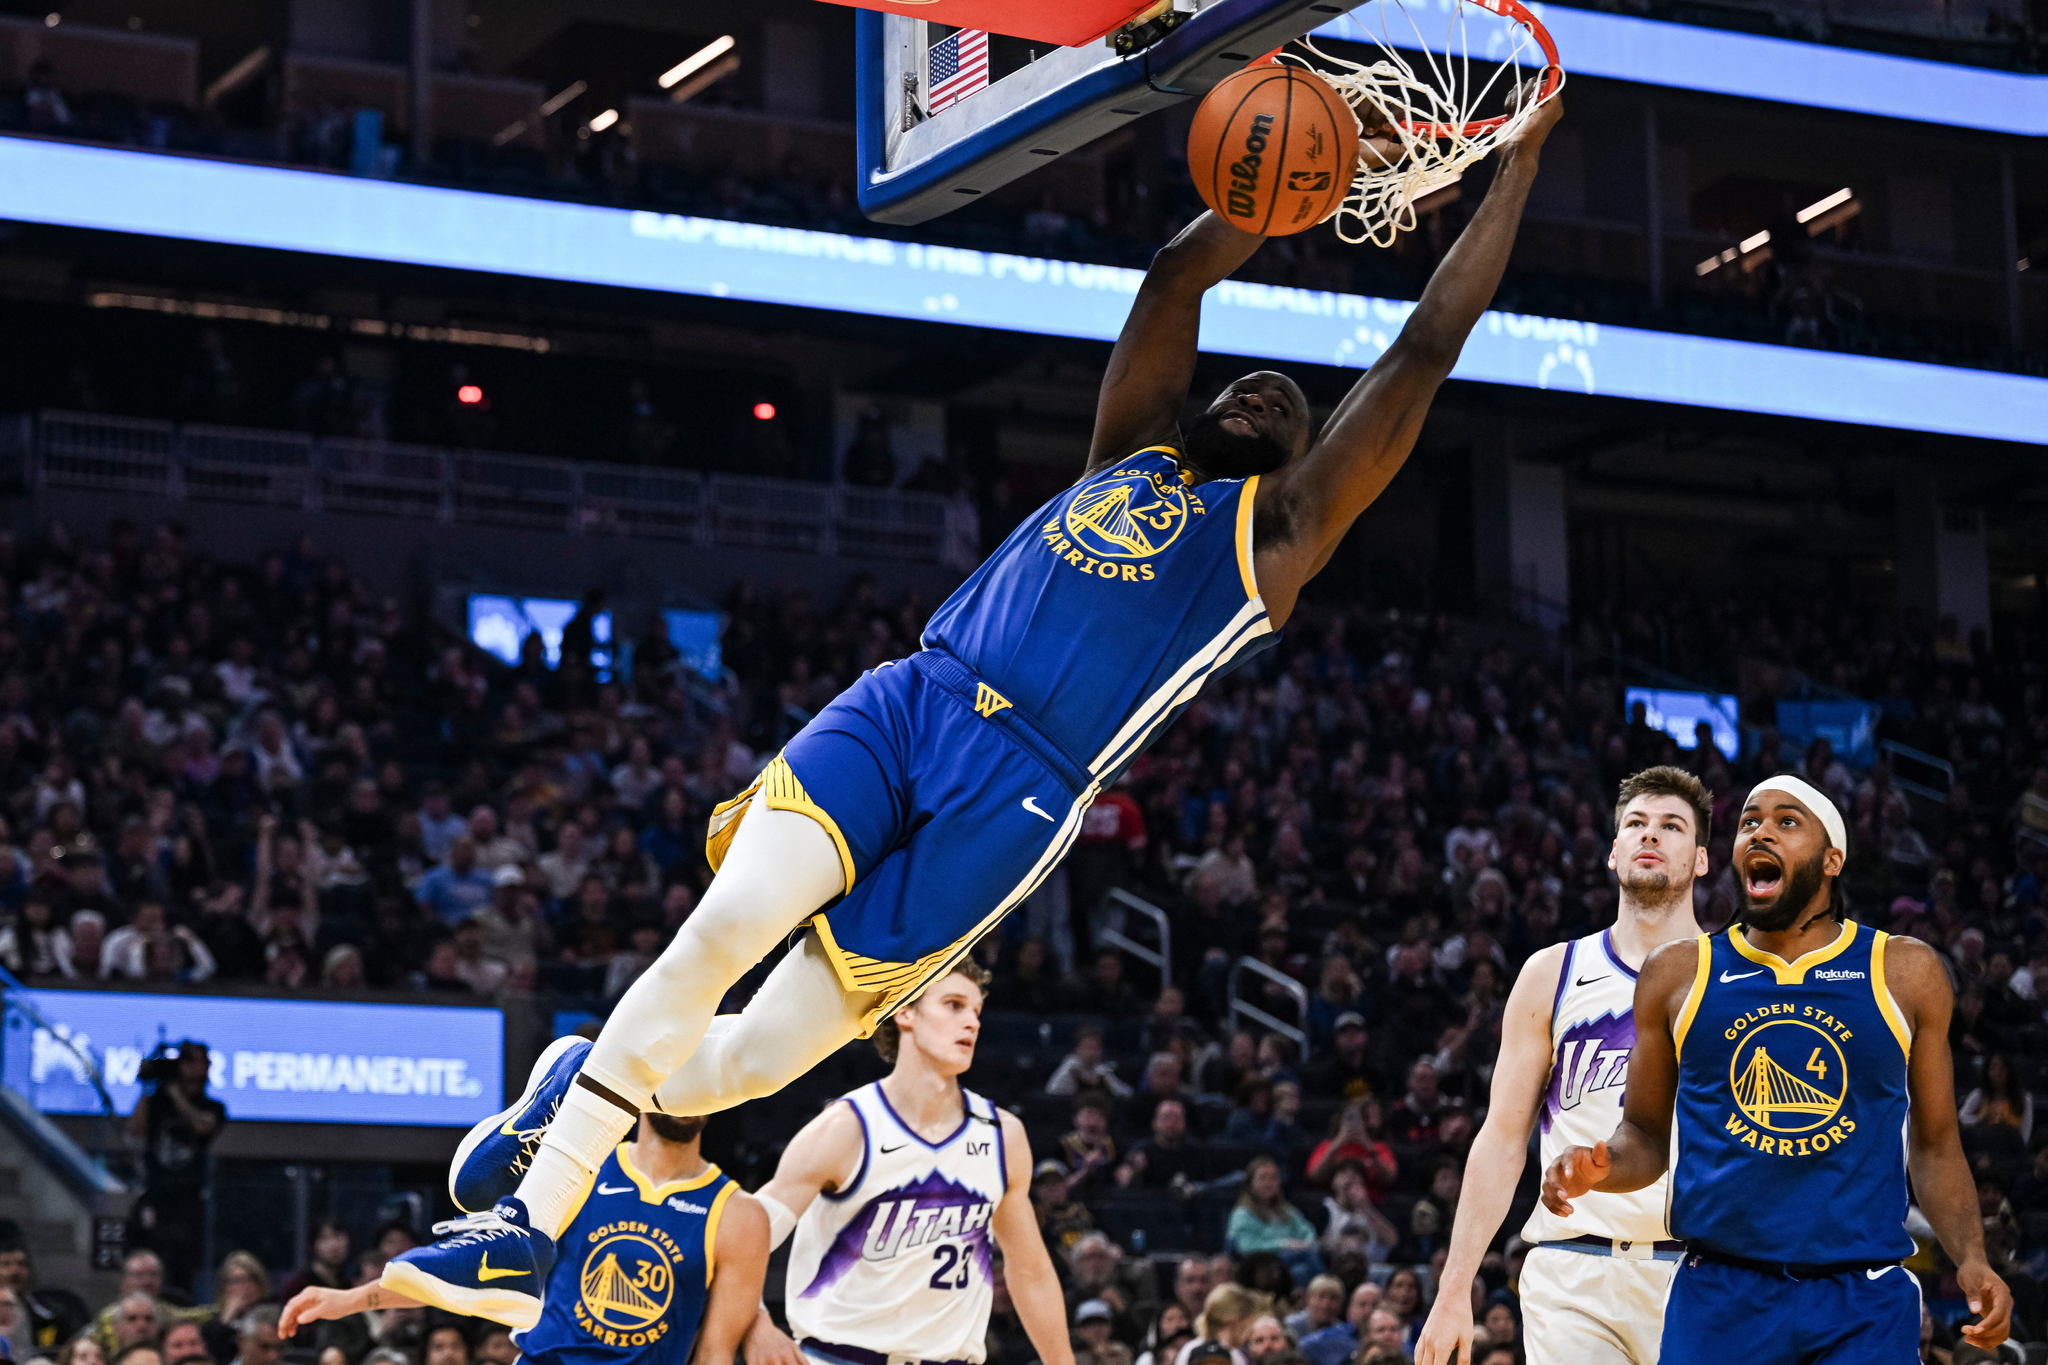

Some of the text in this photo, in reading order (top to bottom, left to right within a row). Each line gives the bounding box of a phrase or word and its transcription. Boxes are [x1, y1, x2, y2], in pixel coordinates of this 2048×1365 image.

[1227, 113, 1275, 218] Wilson
[1112, 469, 1177, 494] GOLDEN
[1129, 500, 1183, 530] 23
[1042, 515, 1155, 582] WARRIORS
[1815, 969, 1865, 981] Rakuten
[1724, 1003, 1853, 1042] GOLDEN STATE
[104, 1045, 227, 1091] KAR
[1559, 1038, 1633, 1111] UT
[1805, 1047, 1828, 1080] 4
[966, 1142, 991, 1156] LVT
[1725, 1112, 1856, 1156] WARRIORS
[588, 1221, 684, 1264] GOLDEN STATE
[862, 1199, 994, 1262] UTAH
[632, 1259, 667, 1293] 30
[929, 1244, 974, 1290] 23
[574, 1300, 669, 1347] WARRIORS
